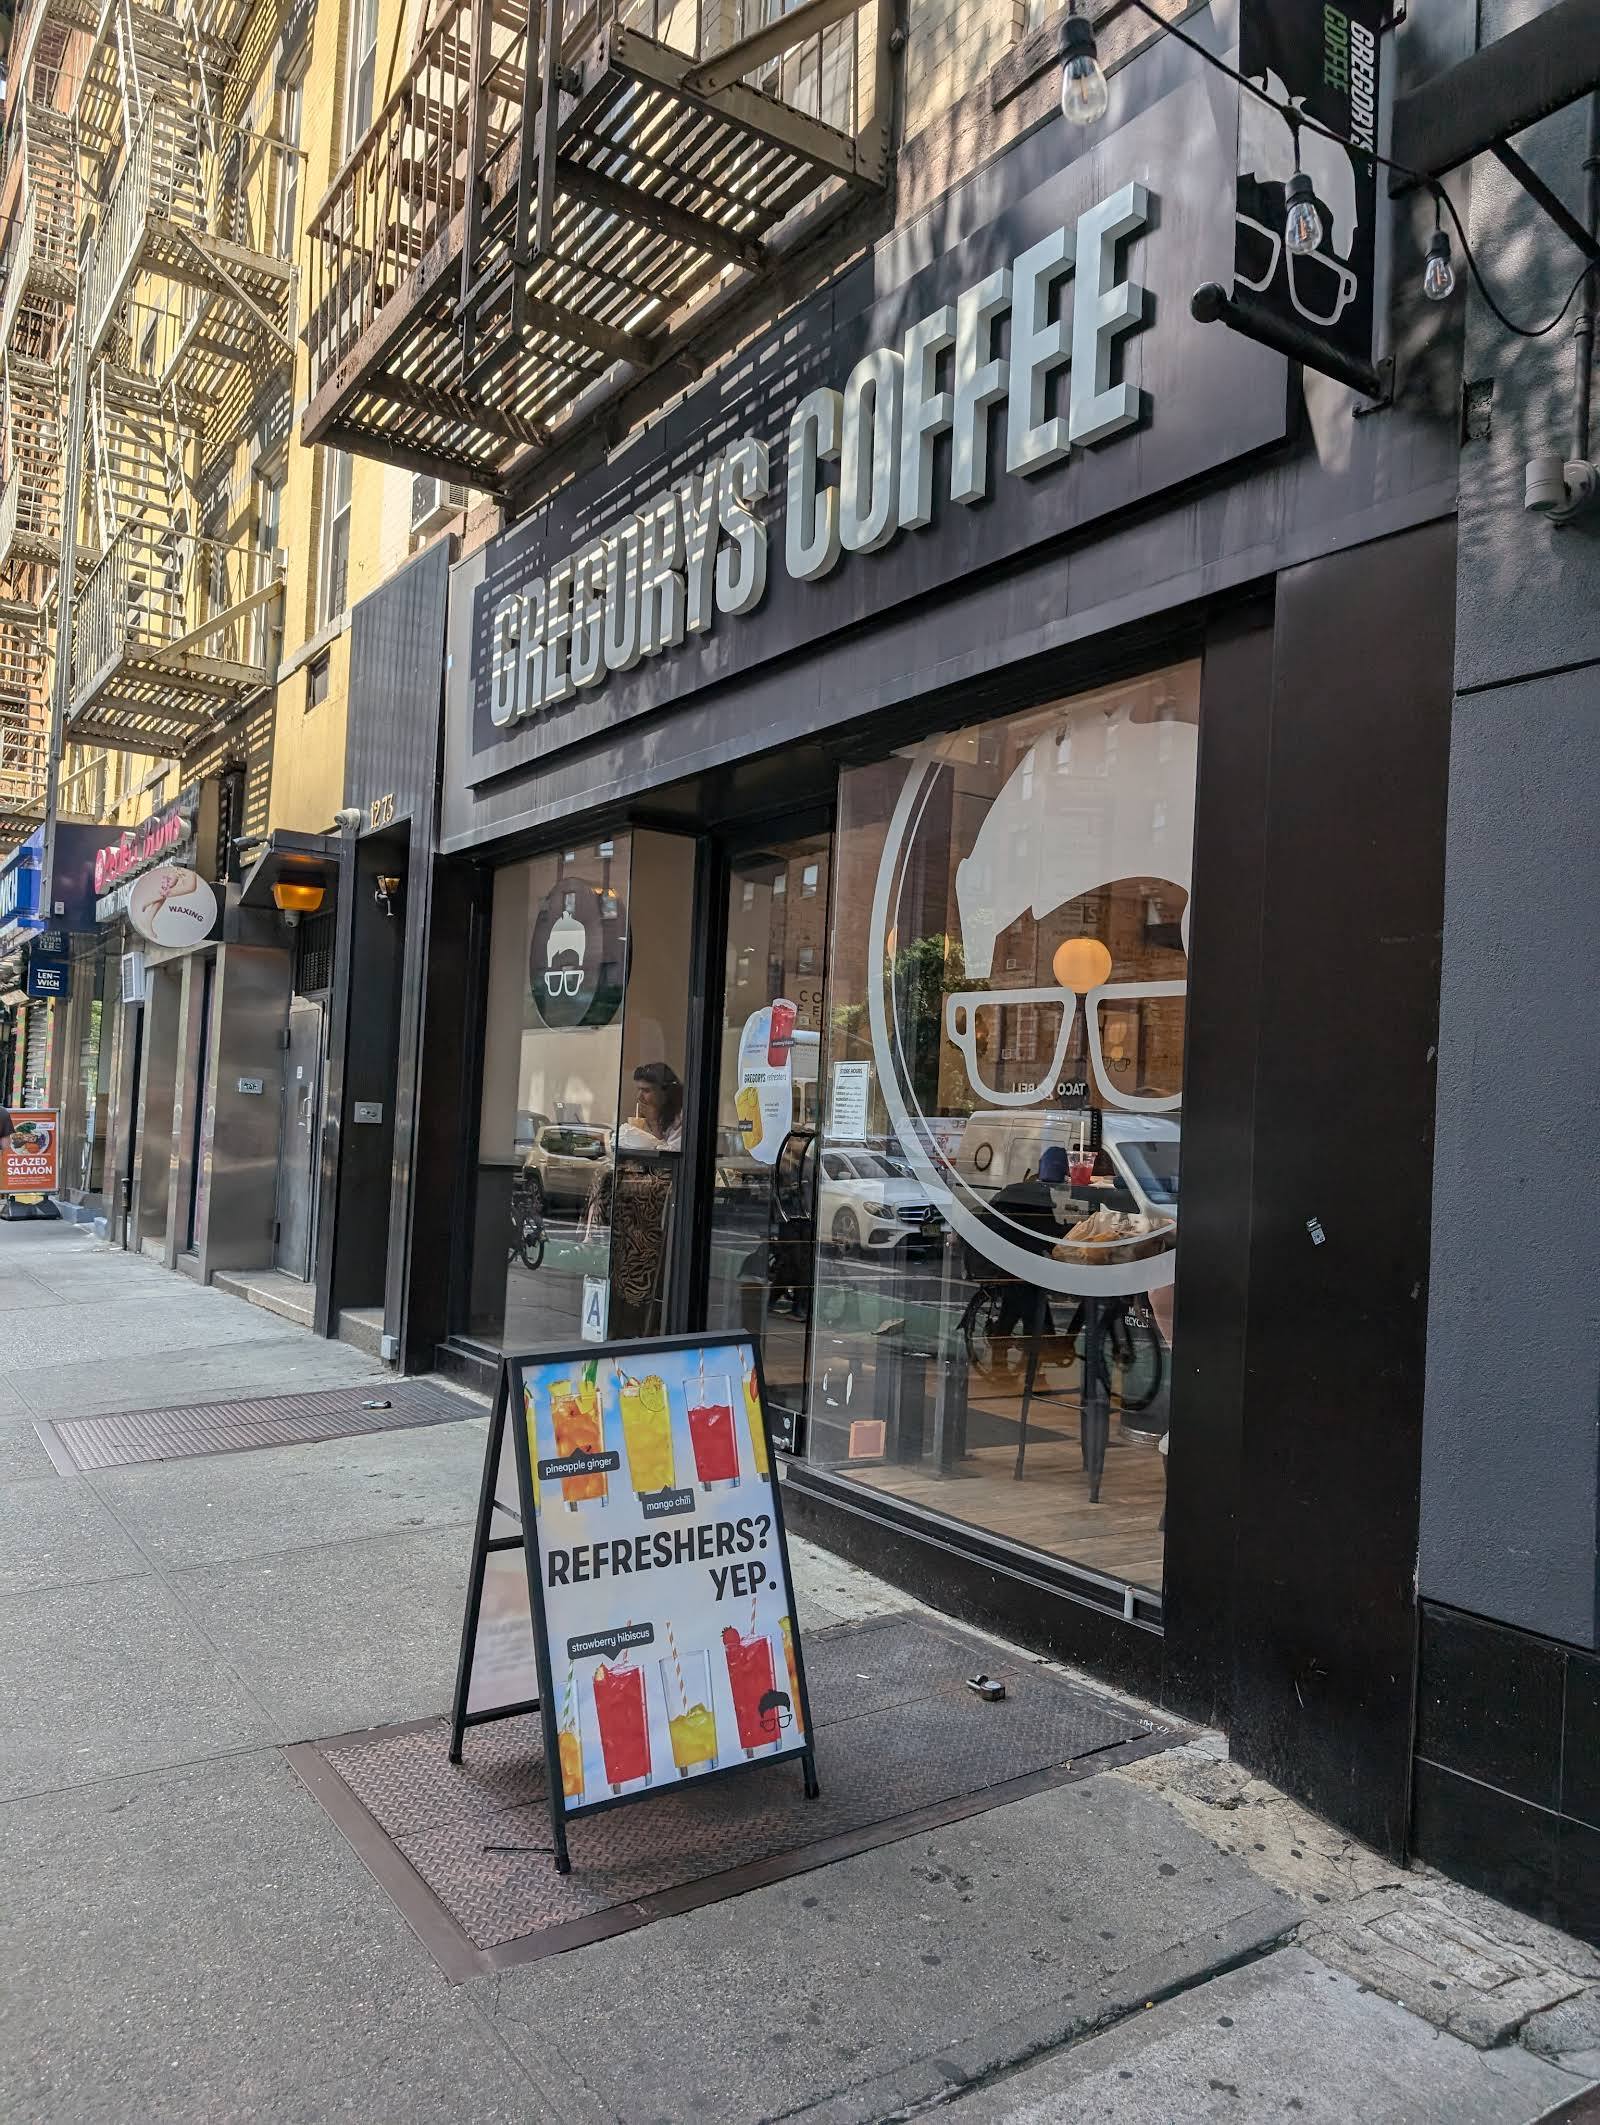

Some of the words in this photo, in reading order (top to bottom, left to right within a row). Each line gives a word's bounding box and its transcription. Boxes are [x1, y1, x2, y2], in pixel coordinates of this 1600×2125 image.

[1323, 3, 1349, 96] COFFEE
[1350, 20, 1375, 154] GREGORYS
[490, 436, 769, 729] GREGORYS
[785, 180, 1148, 582] COFFEE
[168, 905, 204, 922] WAXING
[37, 979, 60, 988] WICH
[7, 1157, 48, 1167] GLAZED
[7, 1166, 53, 1176] SALMON
[586, 1290, 601, 1327] A
[545, 1460, 586, 1476] pineapple
[587, 1457, 613, 1471] ginger
[646, 1499, 673, 1511] mango
[674, 1495, 692, 1506] chili
[547, 1514, 772, 1588] REFRESHERS?
[708, 1560, 778, 1602] YEP.
[571, 1637, 617, 1653] strawberry
[617, 1629, 651, 1644] hibiscus
